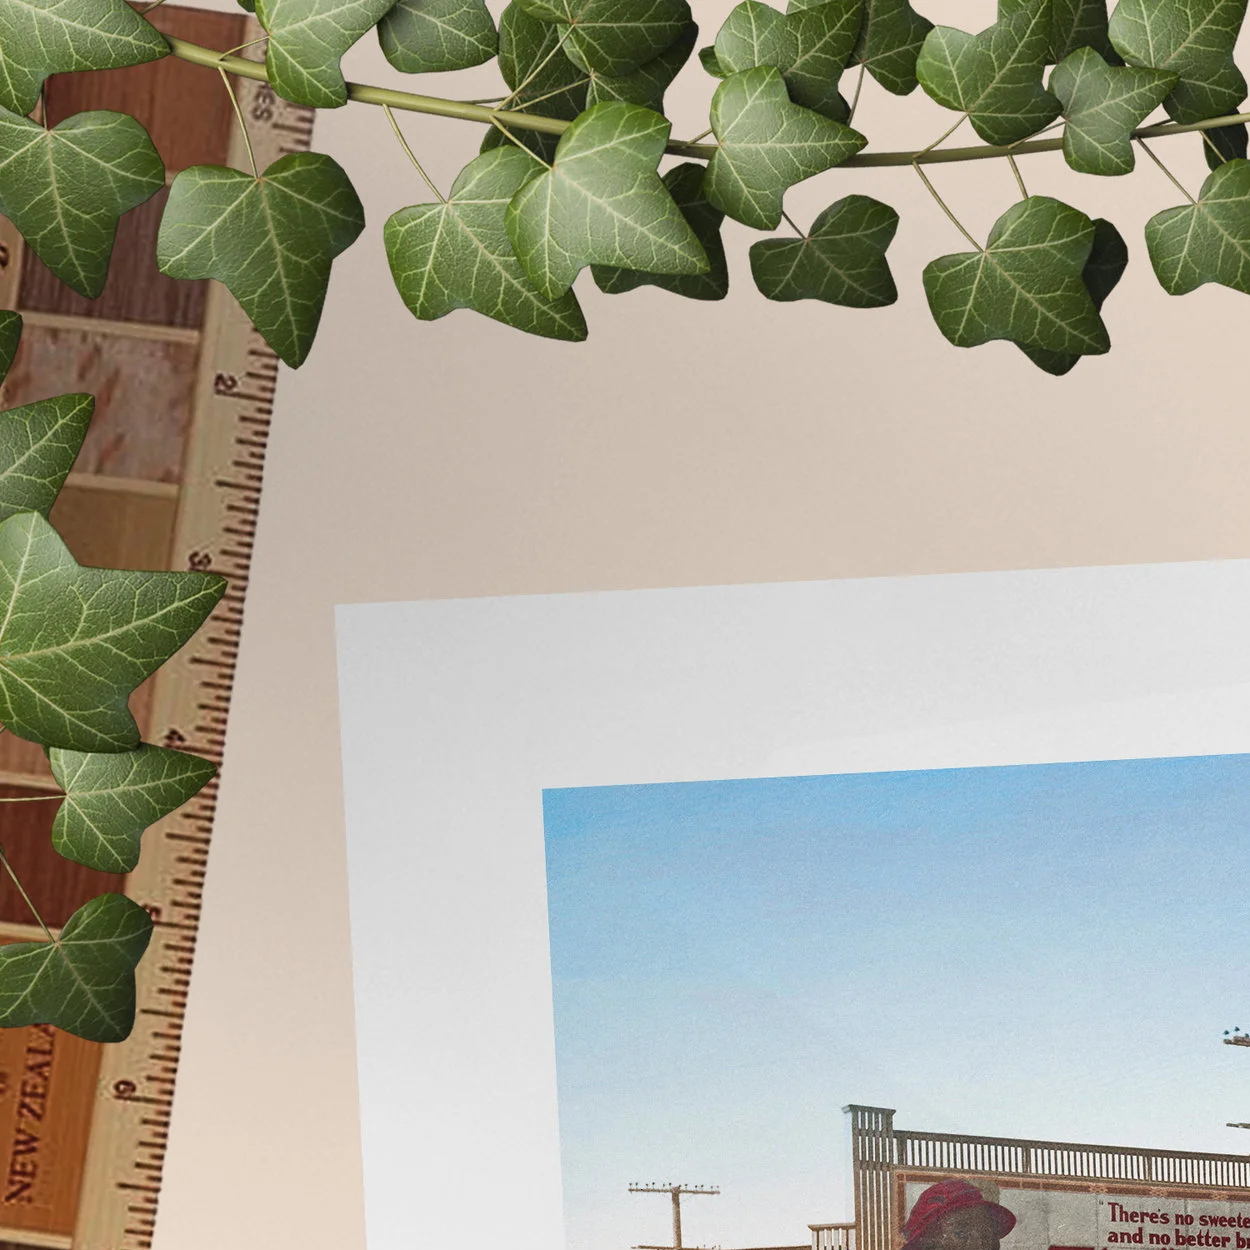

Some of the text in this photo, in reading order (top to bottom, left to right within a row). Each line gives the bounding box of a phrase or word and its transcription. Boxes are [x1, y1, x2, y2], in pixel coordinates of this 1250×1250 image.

[214, 372, 237, 394] 2
[114, 1079, 137, 1097] 6
[3, 1128, 40, 1204] NEW
[1175, 1215, 1195, 1226] no
[1107, 1227, 1144, 1244] and
[1149, 1231, 1171, 1246] no
[1175, 1229, 1231, 1248] better
